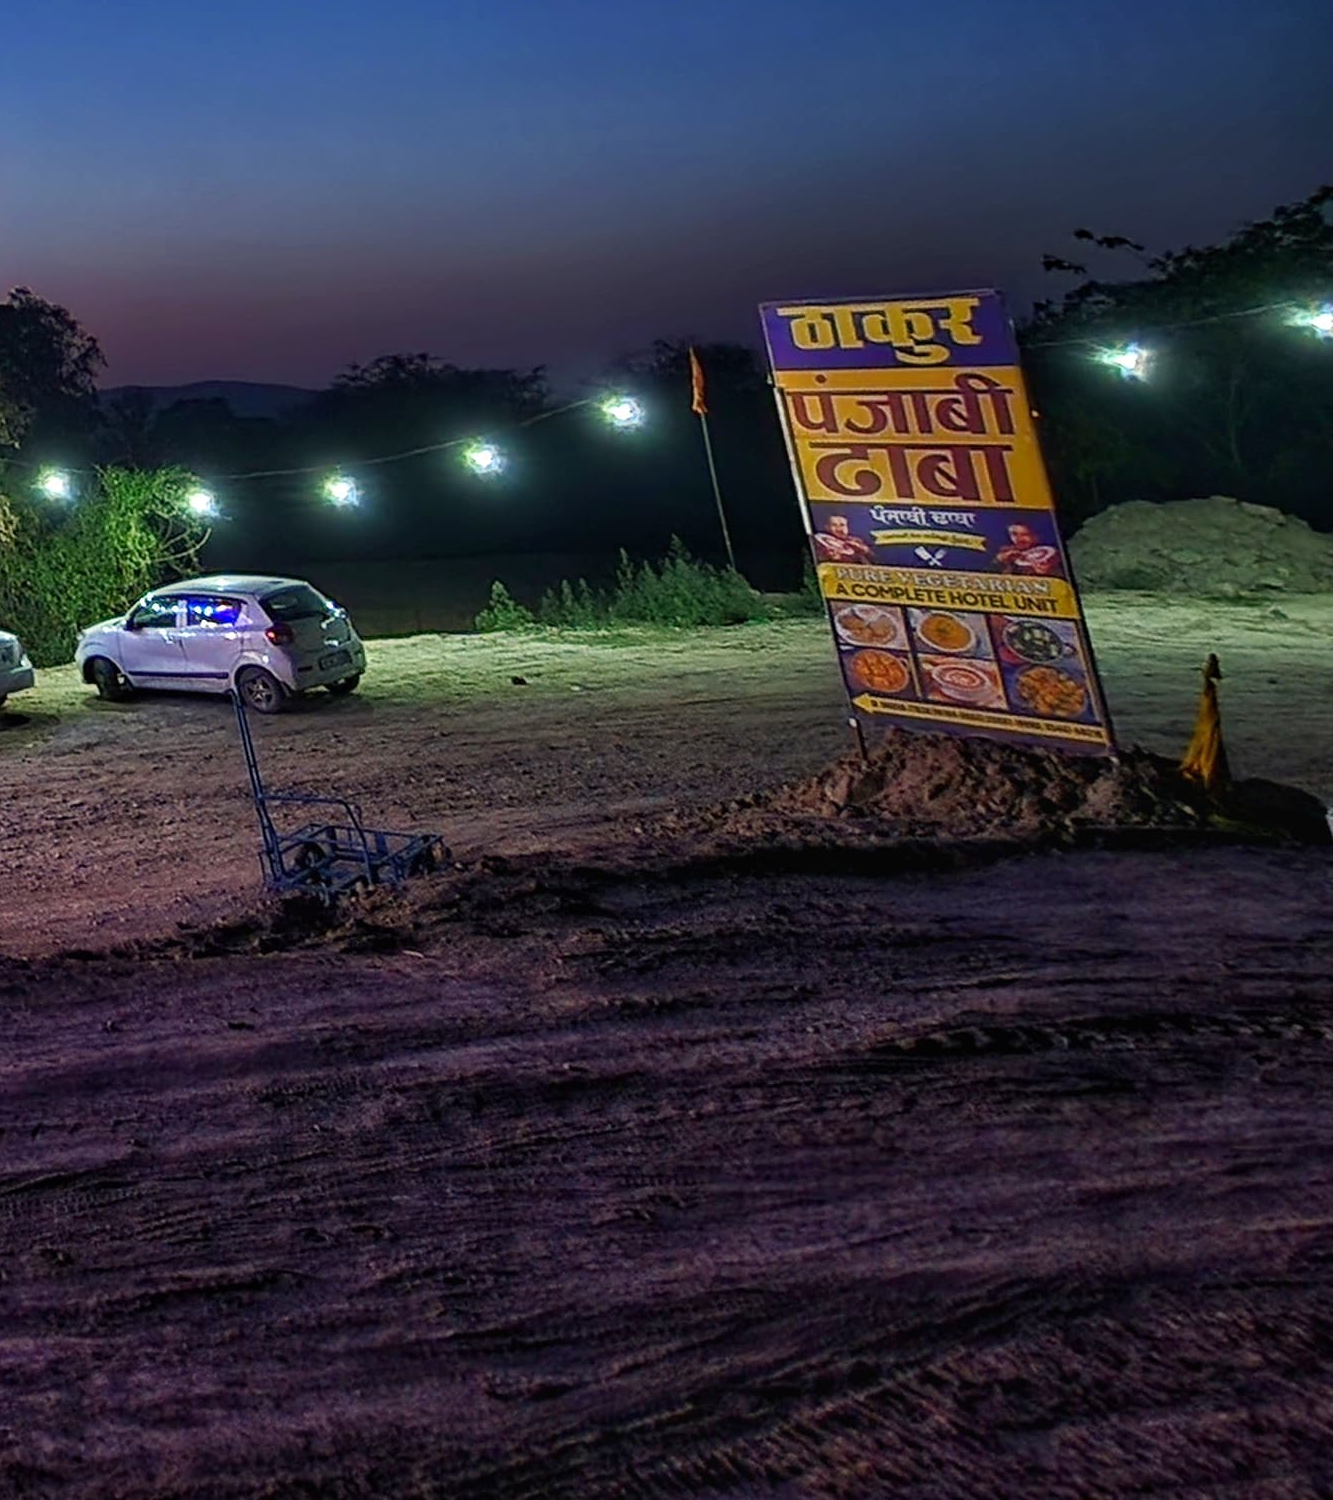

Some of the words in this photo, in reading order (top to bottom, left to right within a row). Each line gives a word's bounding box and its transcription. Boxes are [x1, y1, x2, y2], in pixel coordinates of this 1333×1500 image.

[777, 297, 982, 366] ठाकुर
[786, 372, 1016, 435] पंजाबी
[809, 441, 1015, 503] ढाबा
[835, 566, 893, 583] PURE
[897, 571, 1051, 595] VEGETARIAN
[835, 583, 849, 596] A
[851, 584, 948, 605] COMPLETE
[950, 591, 1007, 610] HOTEL
[1014, 597, 1059, 613] UNIT
